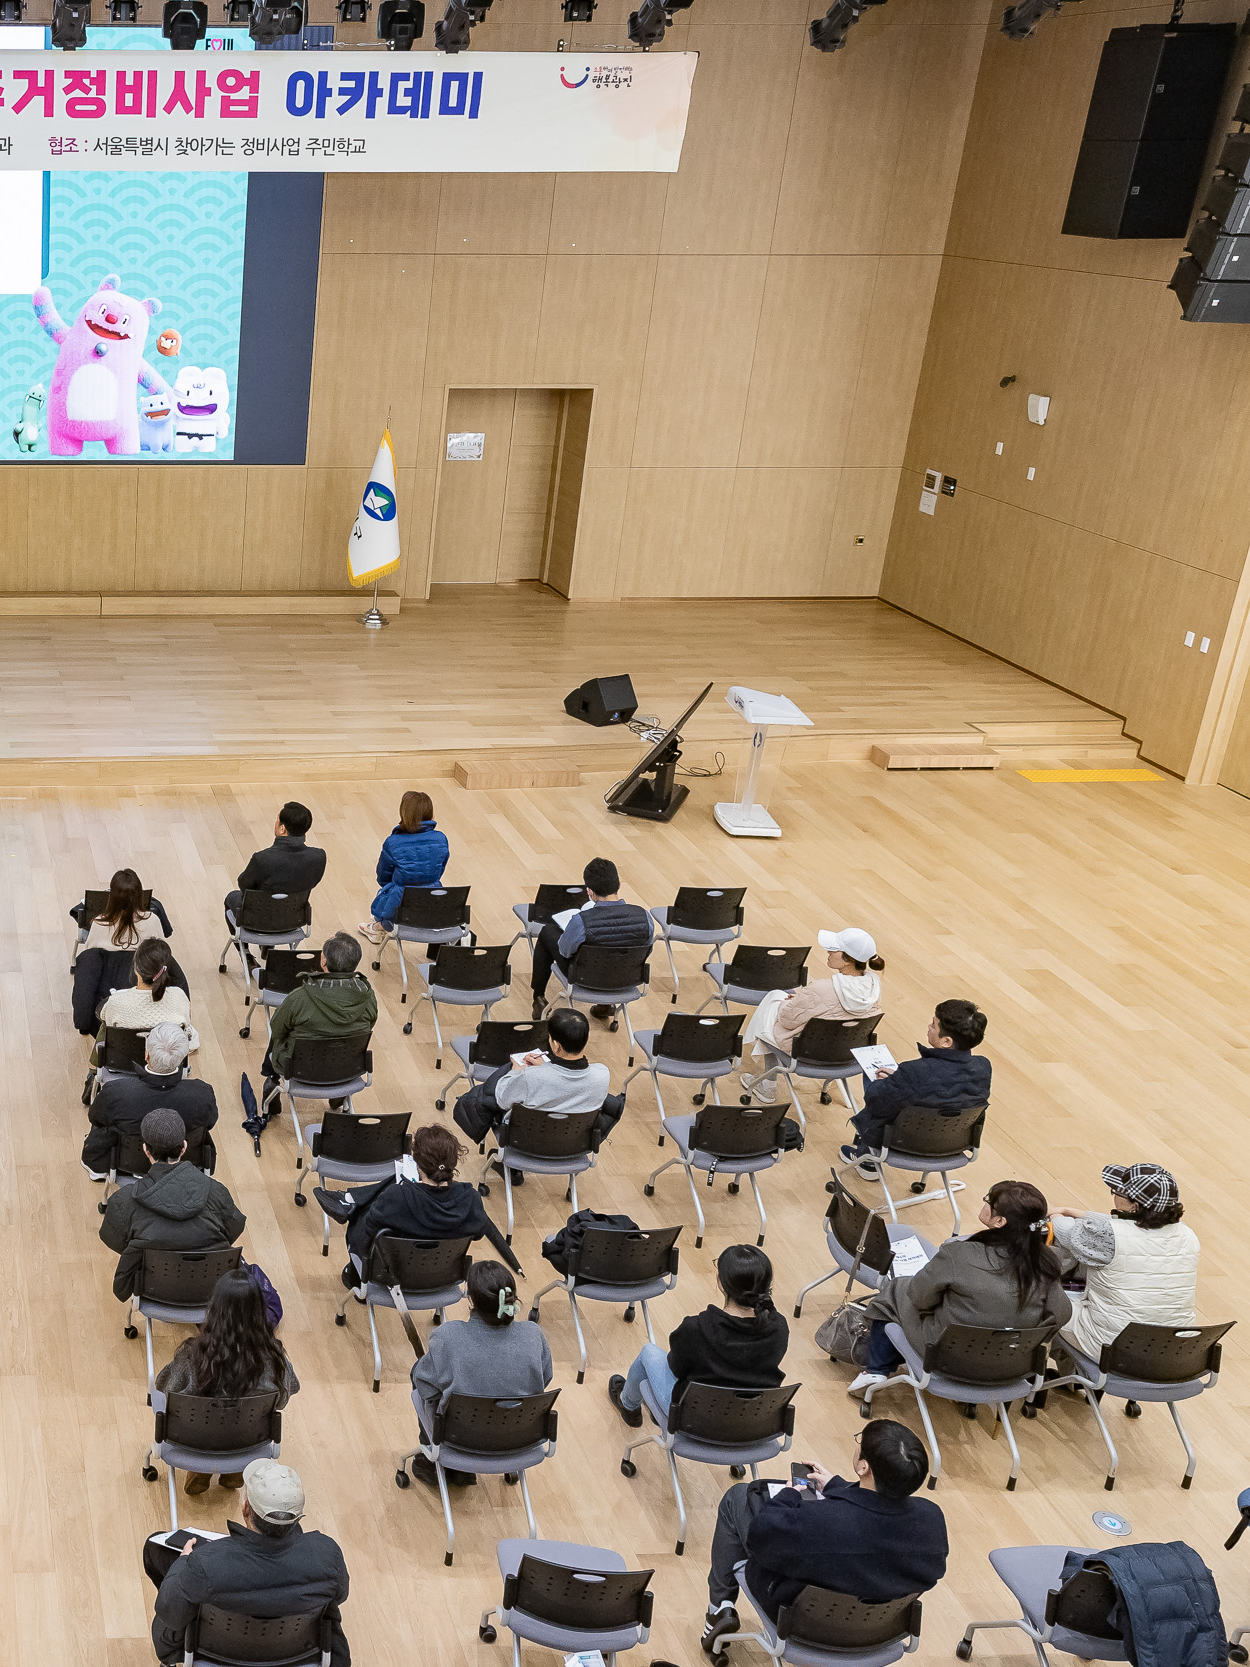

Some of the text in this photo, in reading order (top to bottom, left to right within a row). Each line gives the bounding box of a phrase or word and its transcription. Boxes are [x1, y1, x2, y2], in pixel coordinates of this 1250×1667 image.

[592, 73, 633, 89] 행복광진
[285, 70, 484, 120] 아카데미
[48, 136, 80, 156] 협조
[92, 136, 169, 157] 서울특별시
[174, 136, 236, 157] 찾아가는
[240, 137, 301, 157] 정비사업
[305, 137, 367, 157] 주민학교
